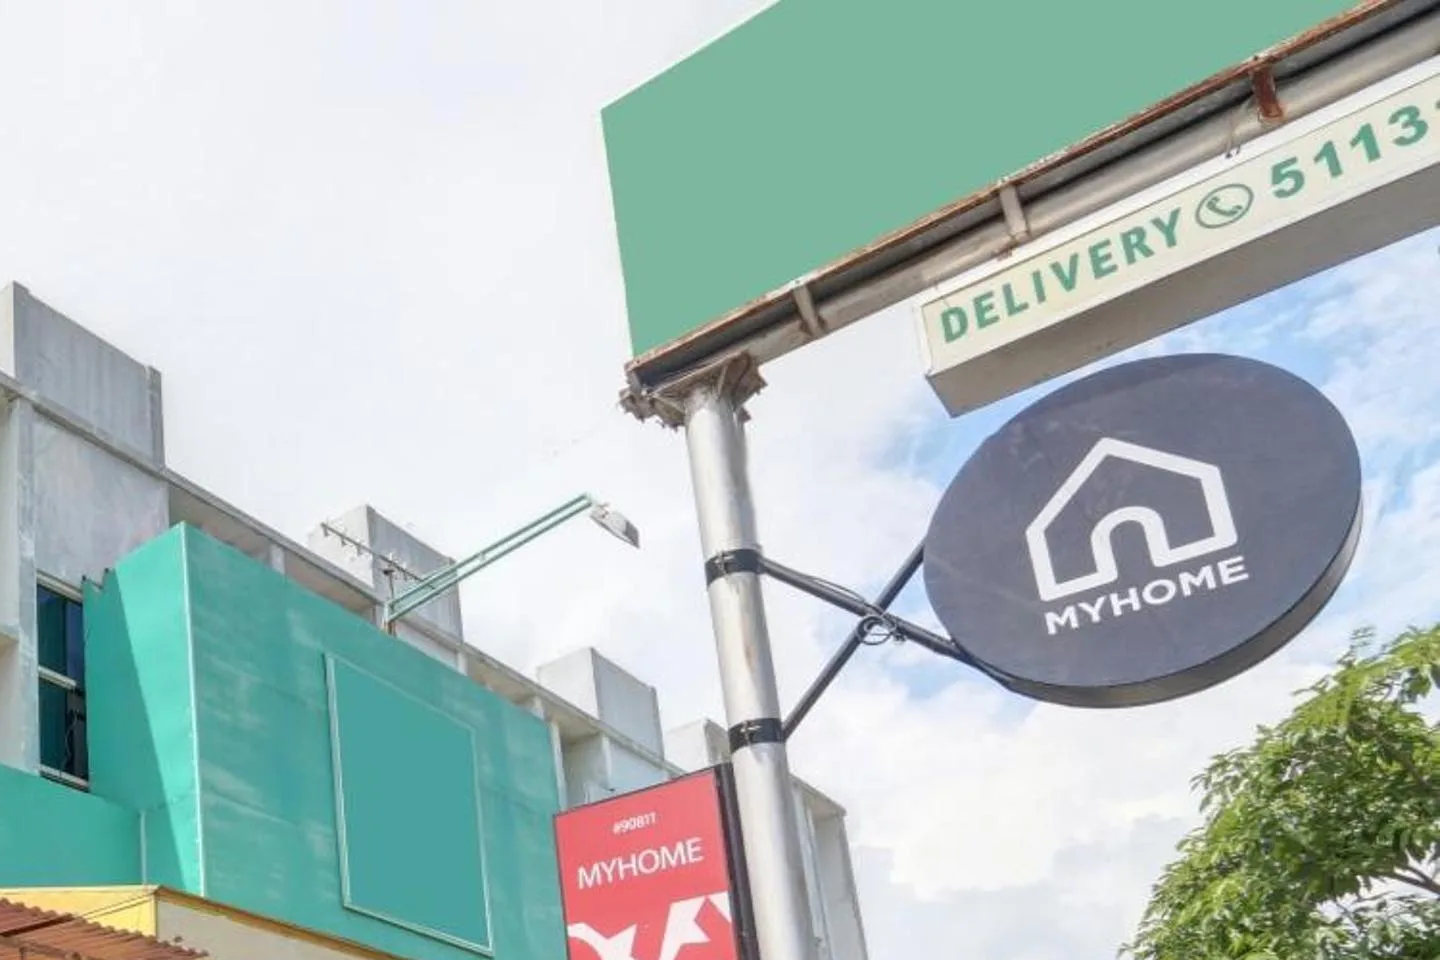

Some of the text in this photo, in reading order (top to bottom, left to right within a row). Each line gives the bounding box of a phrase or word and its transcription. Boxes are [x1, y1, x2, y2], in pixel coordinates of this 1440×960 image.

[941, 99, 1440, 344] DELIVERY 5113
[1044, 555, 1249, 635] MYHOME
[577, 837, 704, 890] MYHOME
